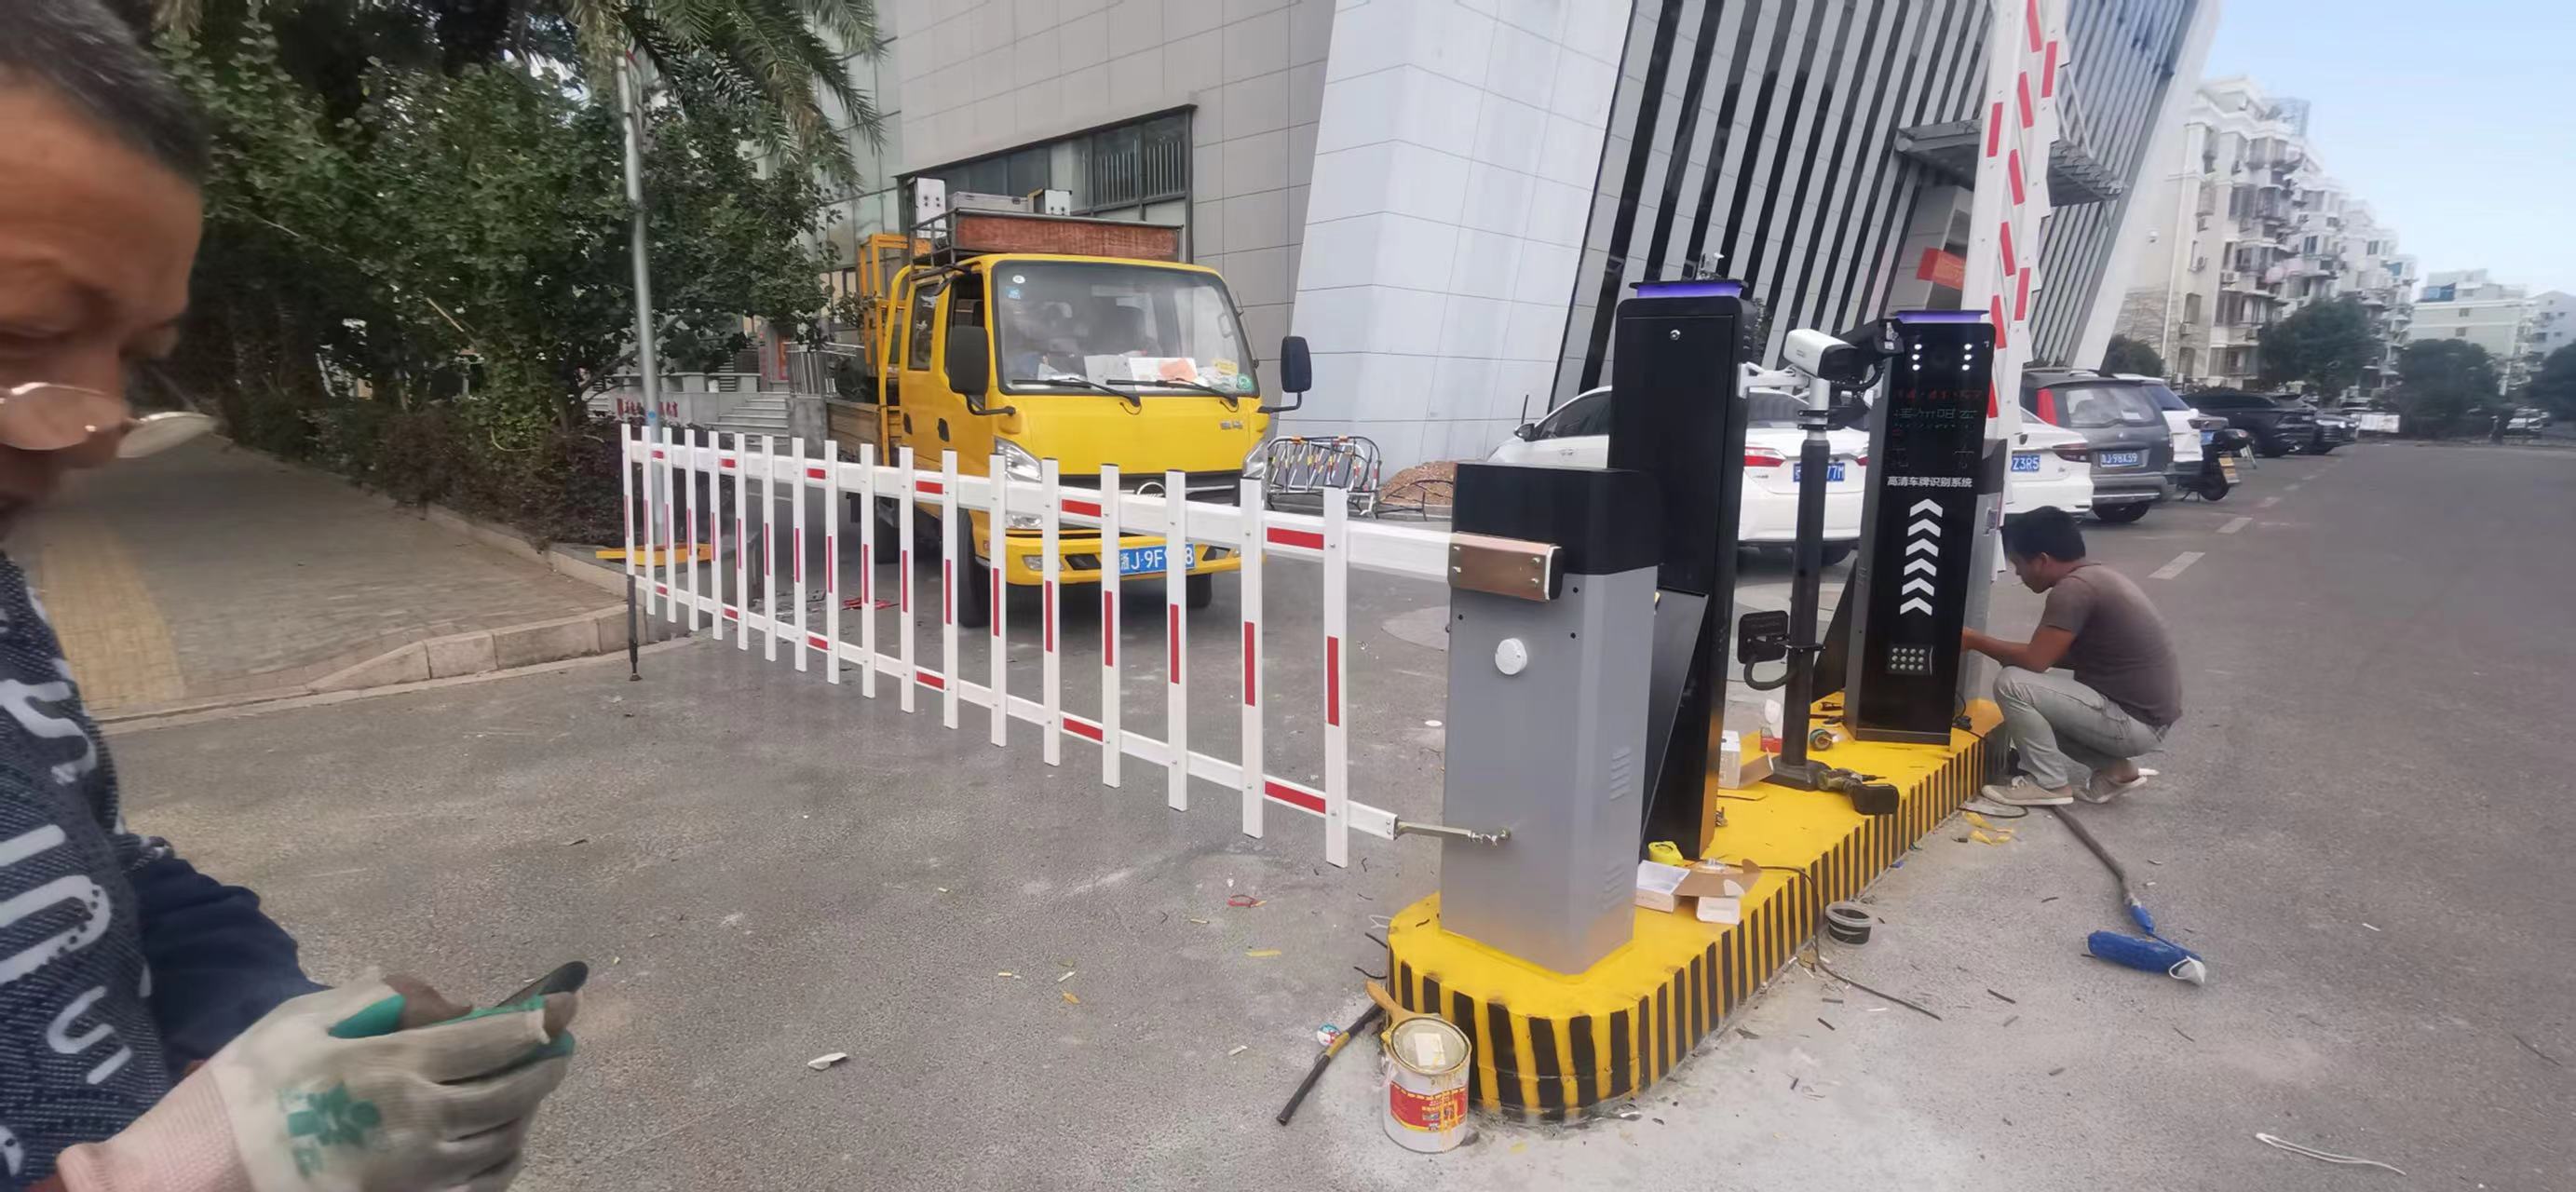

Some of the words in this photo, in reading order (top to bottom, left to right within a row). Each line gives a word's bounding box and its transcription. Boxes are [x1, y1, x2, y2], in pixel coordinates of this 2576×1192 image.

[2013, 457, 2040, 470] Z3R5
[1887, 476, 1973, 488] 高清车牌识别系统
